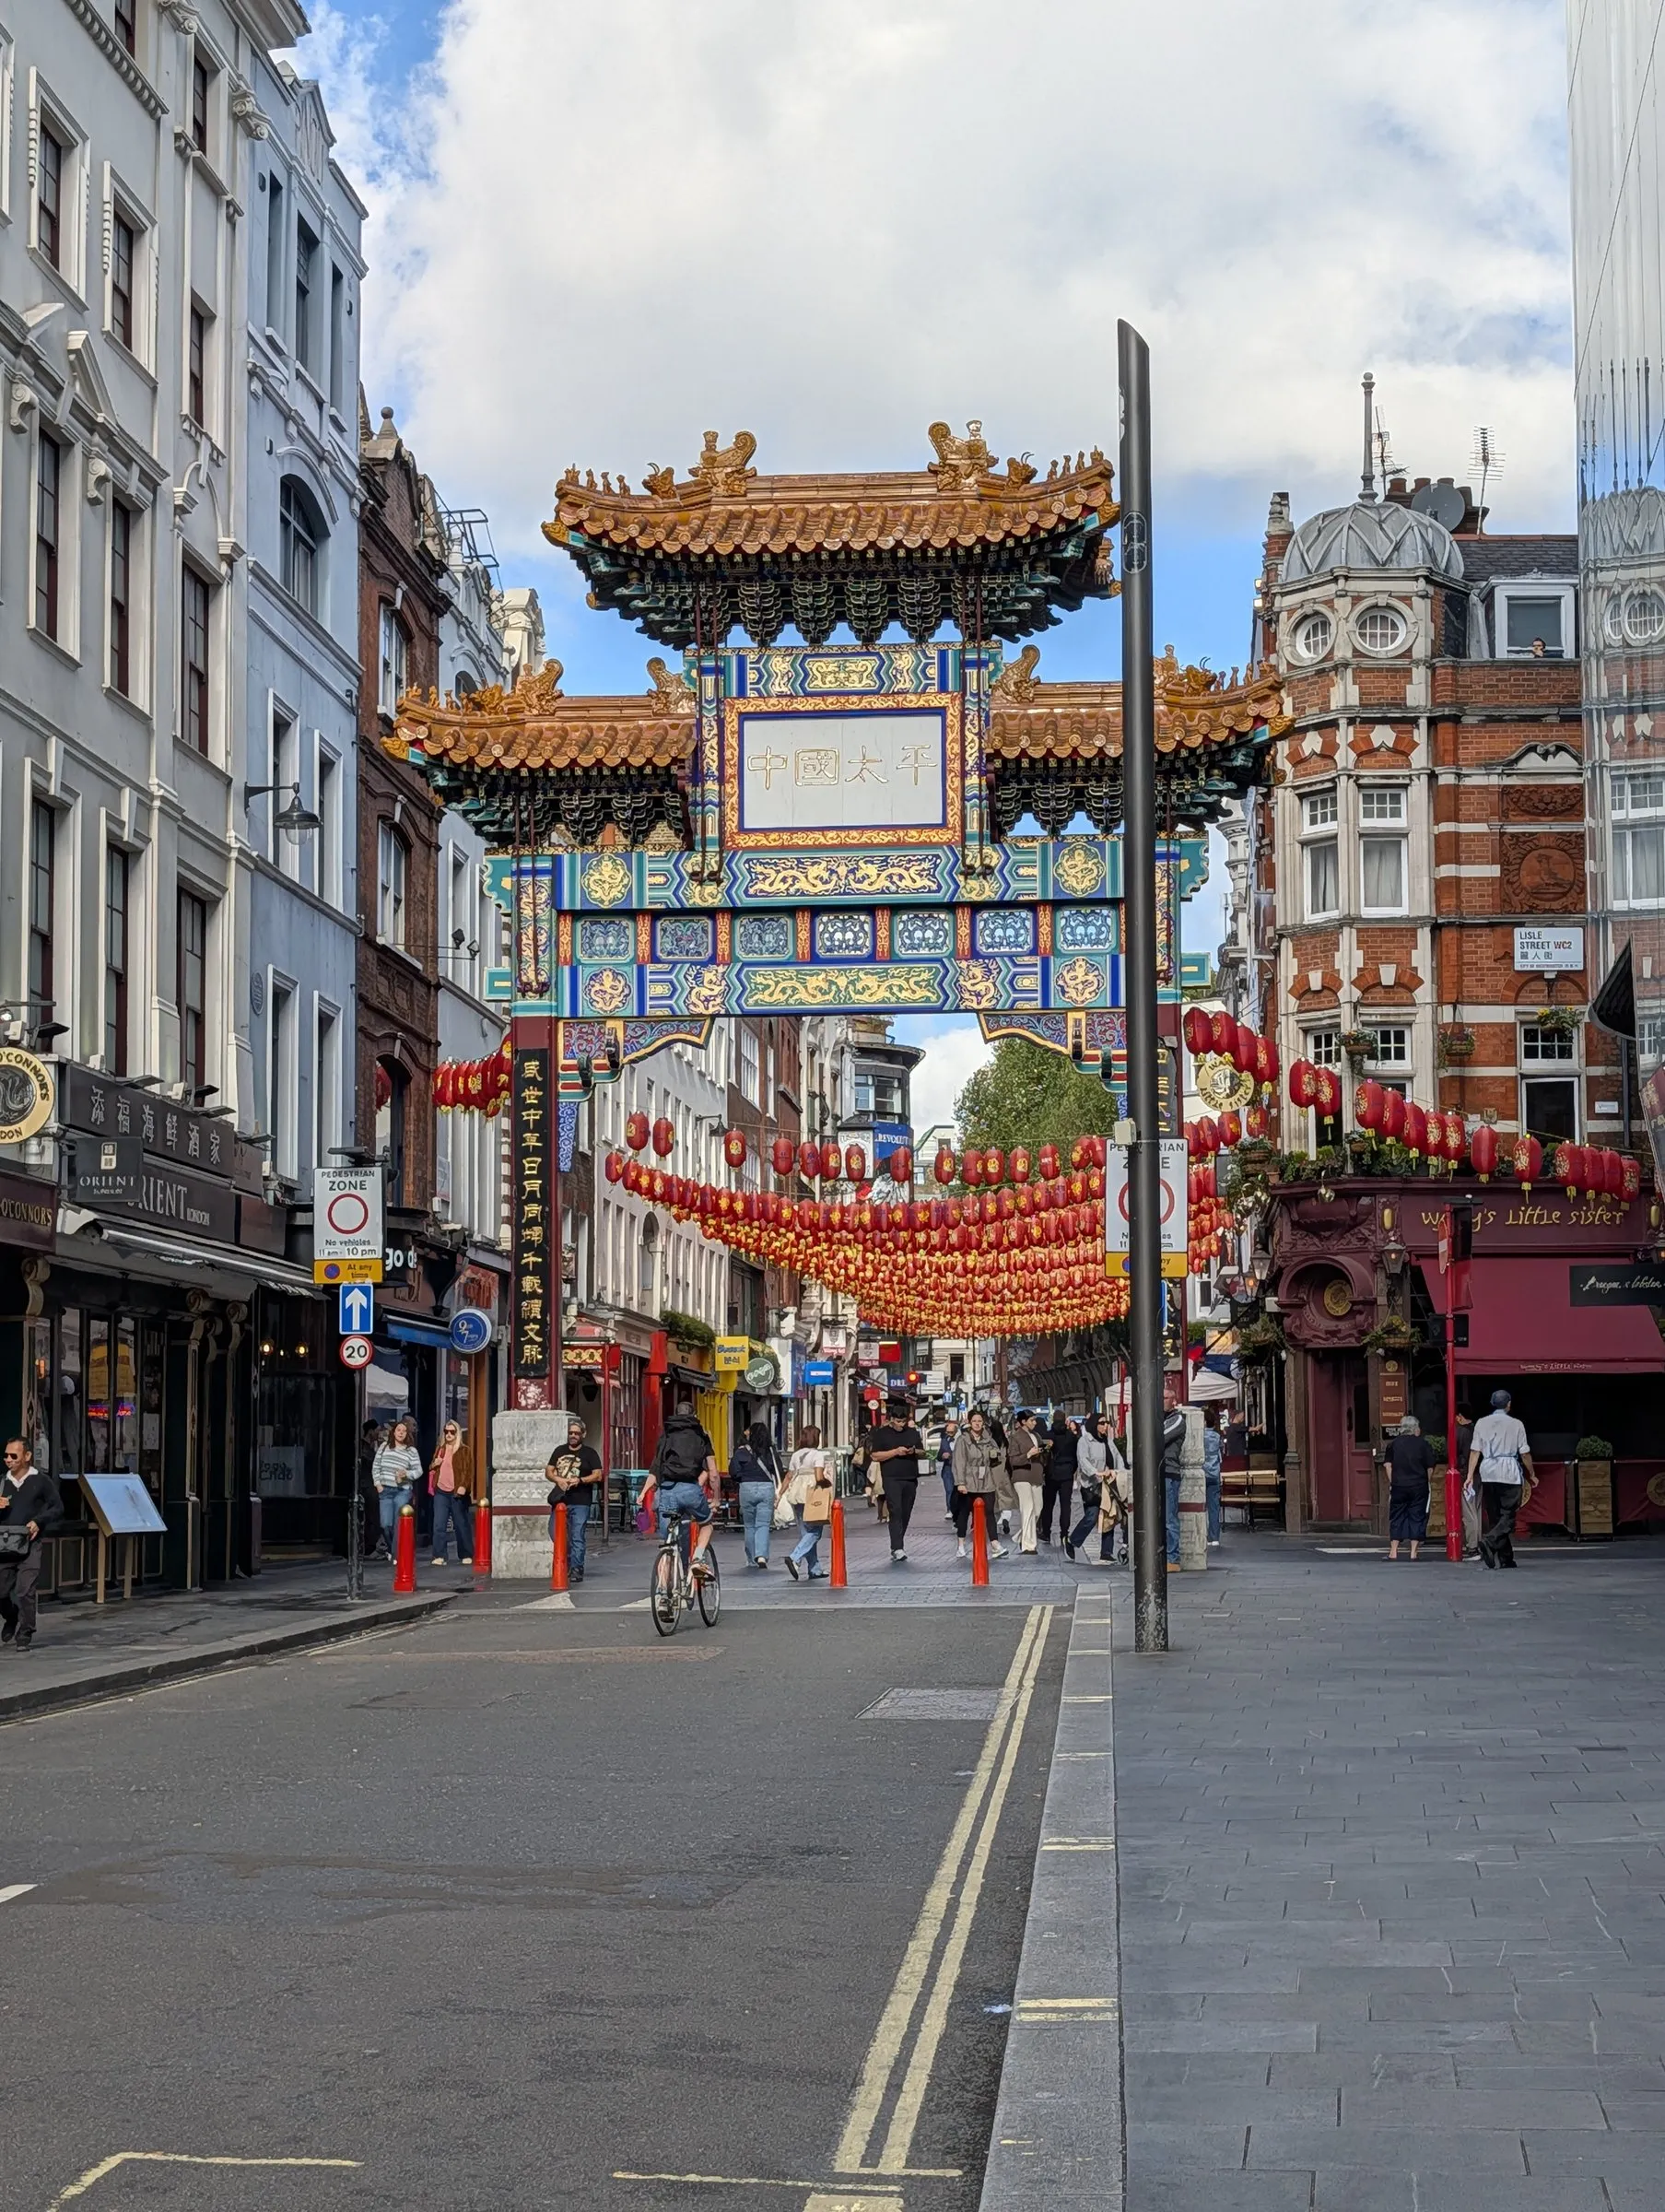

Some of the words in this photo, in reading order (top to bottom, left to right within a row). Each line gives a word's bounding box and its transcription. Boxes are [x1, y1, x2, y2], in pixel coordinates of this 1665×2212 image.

[747, 745, 938, 790] 中國太平
[1519, 931, 1542, 939] LISLE
[1519, 941, 1551, 949] STREET
[1554, 941, 1573, 949] WC2
[322, 1170, 374, 1179] PEDESTRIAN
[79, 1176, 134, 1187] ORIENT
[328, 1180, 368, 1192] ZONE
[1568, 1206, 1624, 1226] sister
[346, 1247, 358, 1255] 10
[345, 1345, 368, 1359] 20
